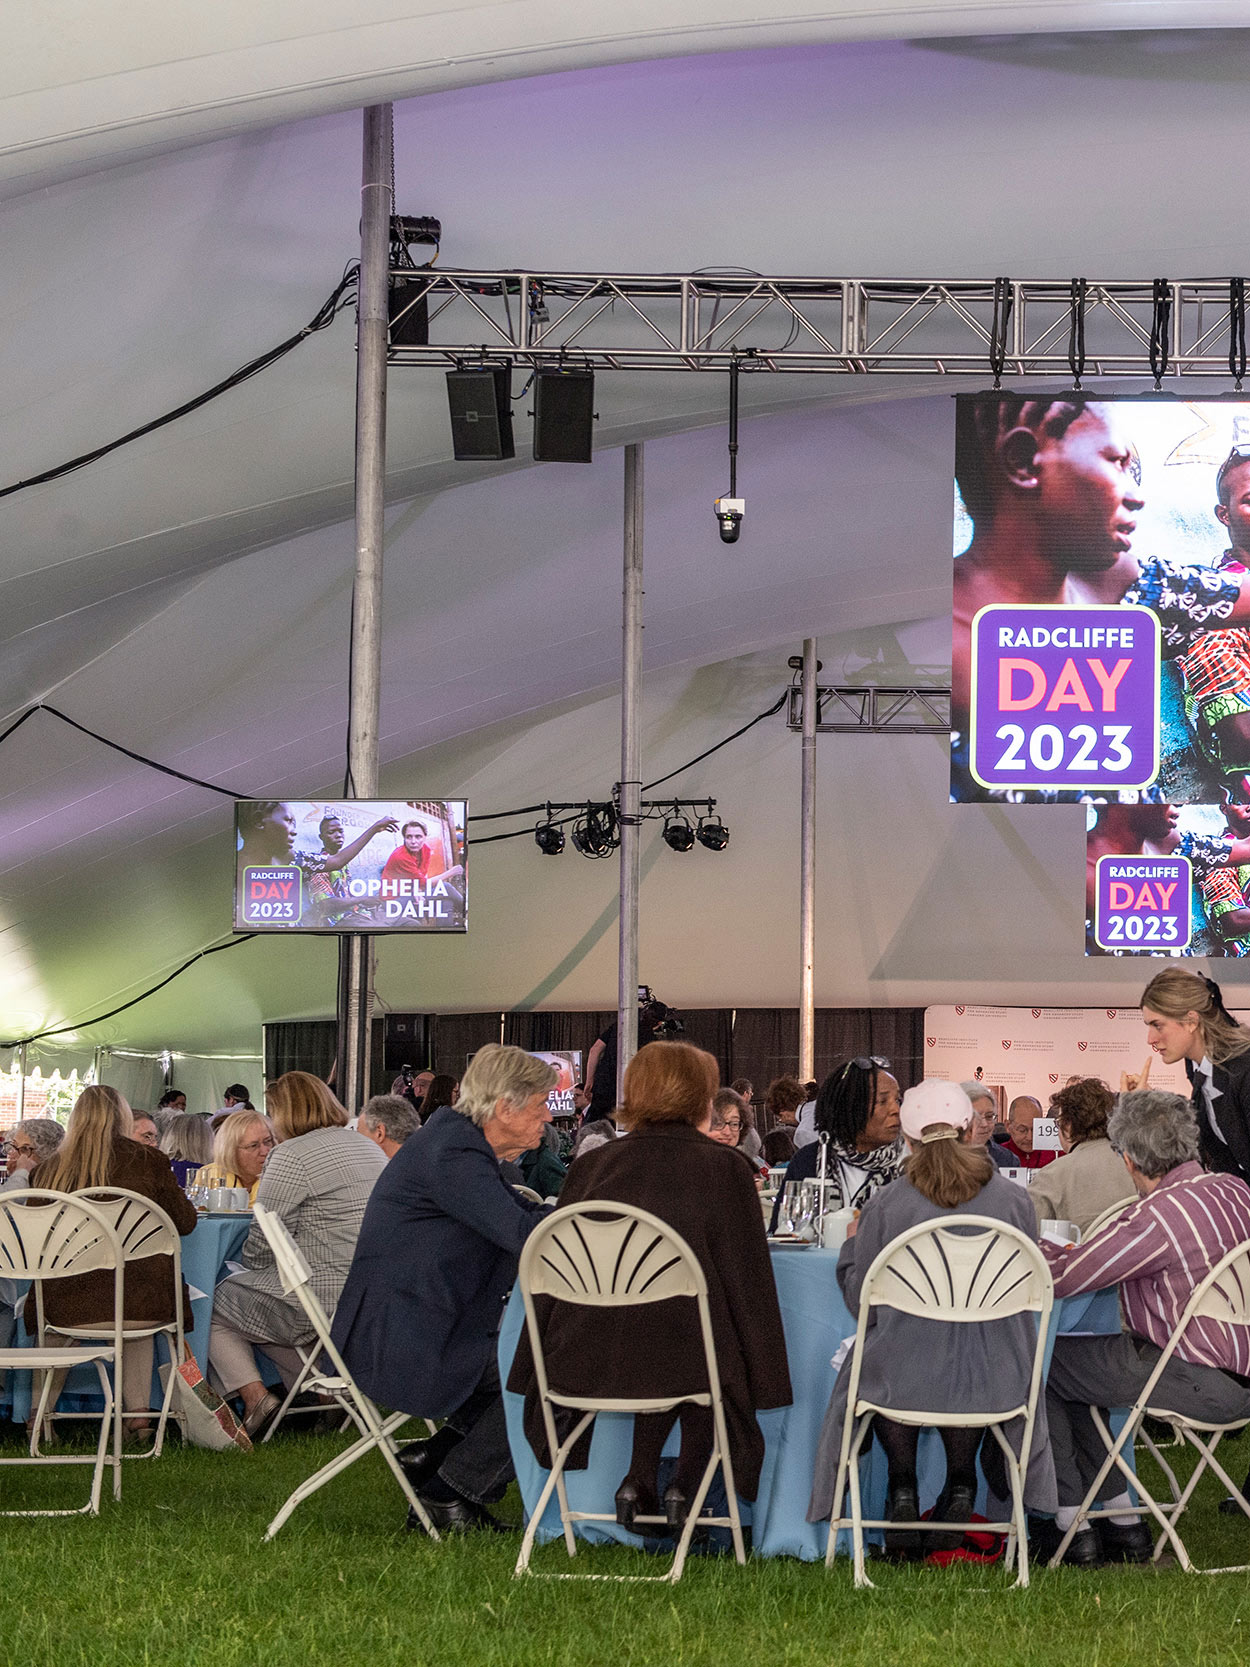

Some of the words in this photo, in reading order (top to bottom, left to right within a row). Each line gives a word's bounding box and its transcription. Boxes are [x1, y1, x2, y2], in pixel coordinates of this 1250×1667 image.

[998, 627, 1135, 649] RADCLIFFE
[998, 658, 1134, 713] DAY
[994, 725, 1134, 772] 2023
[251, 872, 294, 880] RADCLIFFE
[1109, 866, 1179, 879] RADCLIFFE
[250, 882, 291, 899] DAY
[349, 878, 448, 897] OPHELIA
[1109, 882, 1178, 910] DAY
[250, 902, 294, 918] 2023
[386, 900, 448, 918] DAHL
[1108, 915, 1178, 942] 2023
[1038, 1125, 1059, 1137] 199
